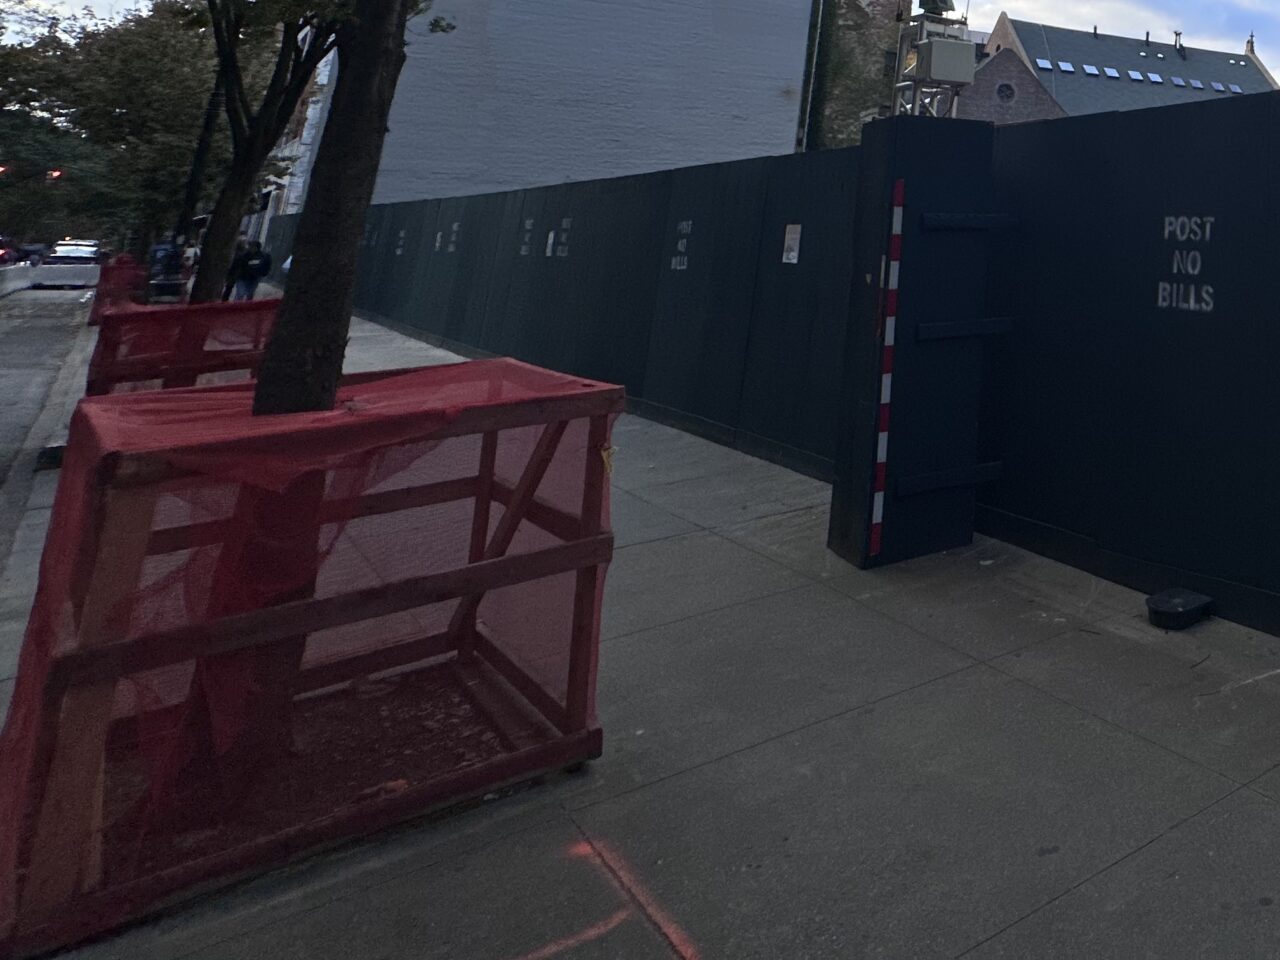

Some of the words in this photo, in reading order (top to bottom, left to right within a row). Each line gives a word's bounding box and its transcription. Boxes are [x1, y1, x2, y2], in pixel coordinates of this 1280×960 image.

[1163, 216, 1215, 242] POST
[1172, 250, 1202, 275] NO
[1157, 281, 1215, 312] BILLS
